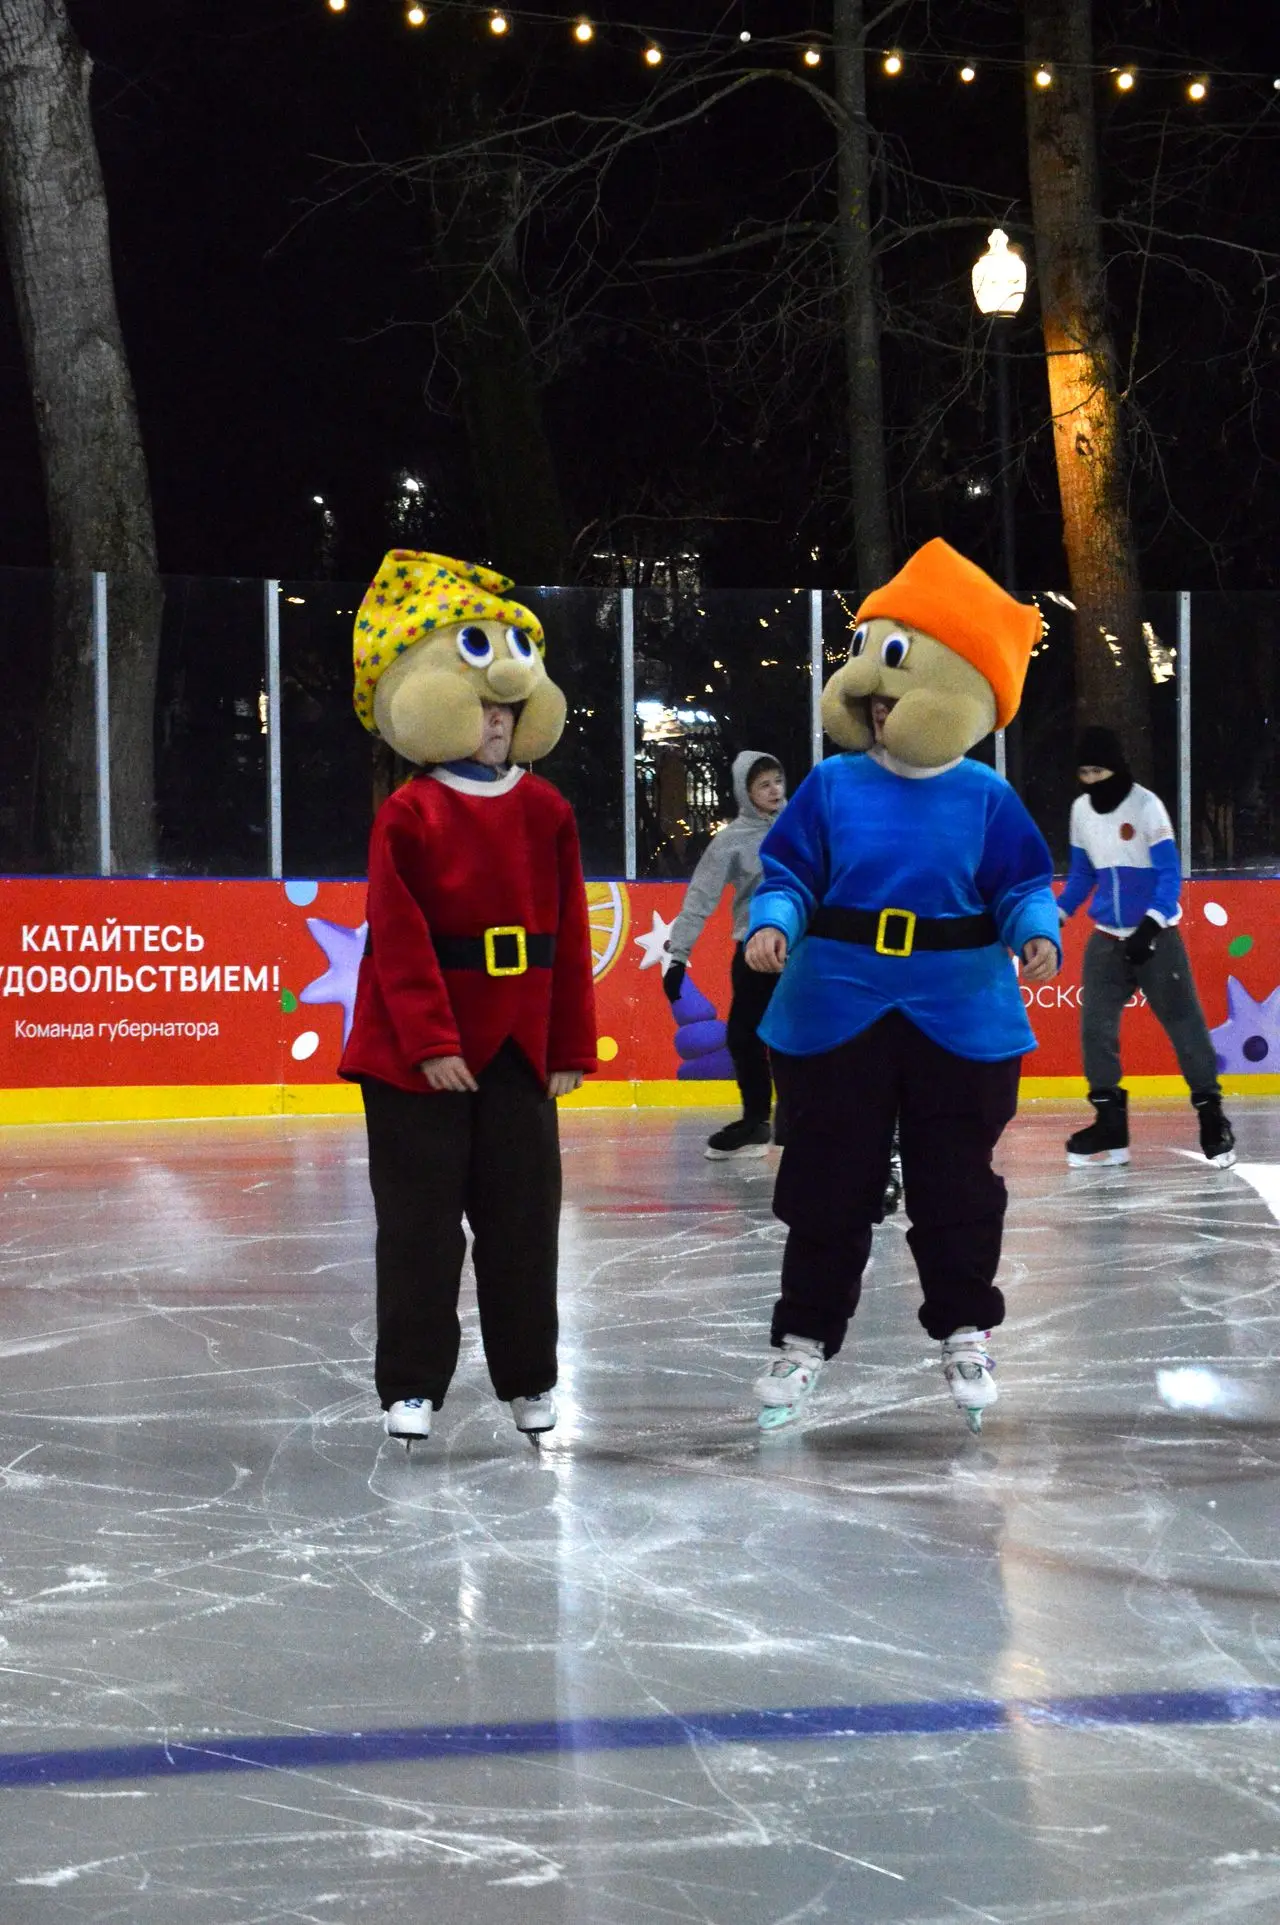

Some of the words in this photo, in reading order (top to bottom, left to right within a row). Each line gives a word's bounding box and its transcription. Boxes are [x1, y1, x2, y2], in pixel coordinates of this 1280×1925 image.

[21, 917, 205, 953] КАТАЙТЕСЬ
[0, 965, 280, 997] ДОВОЛЬСТВИЕМ!
[14, 1019, 95, 1040] Команда
[98, 1018, 220, 1042] губернатора
